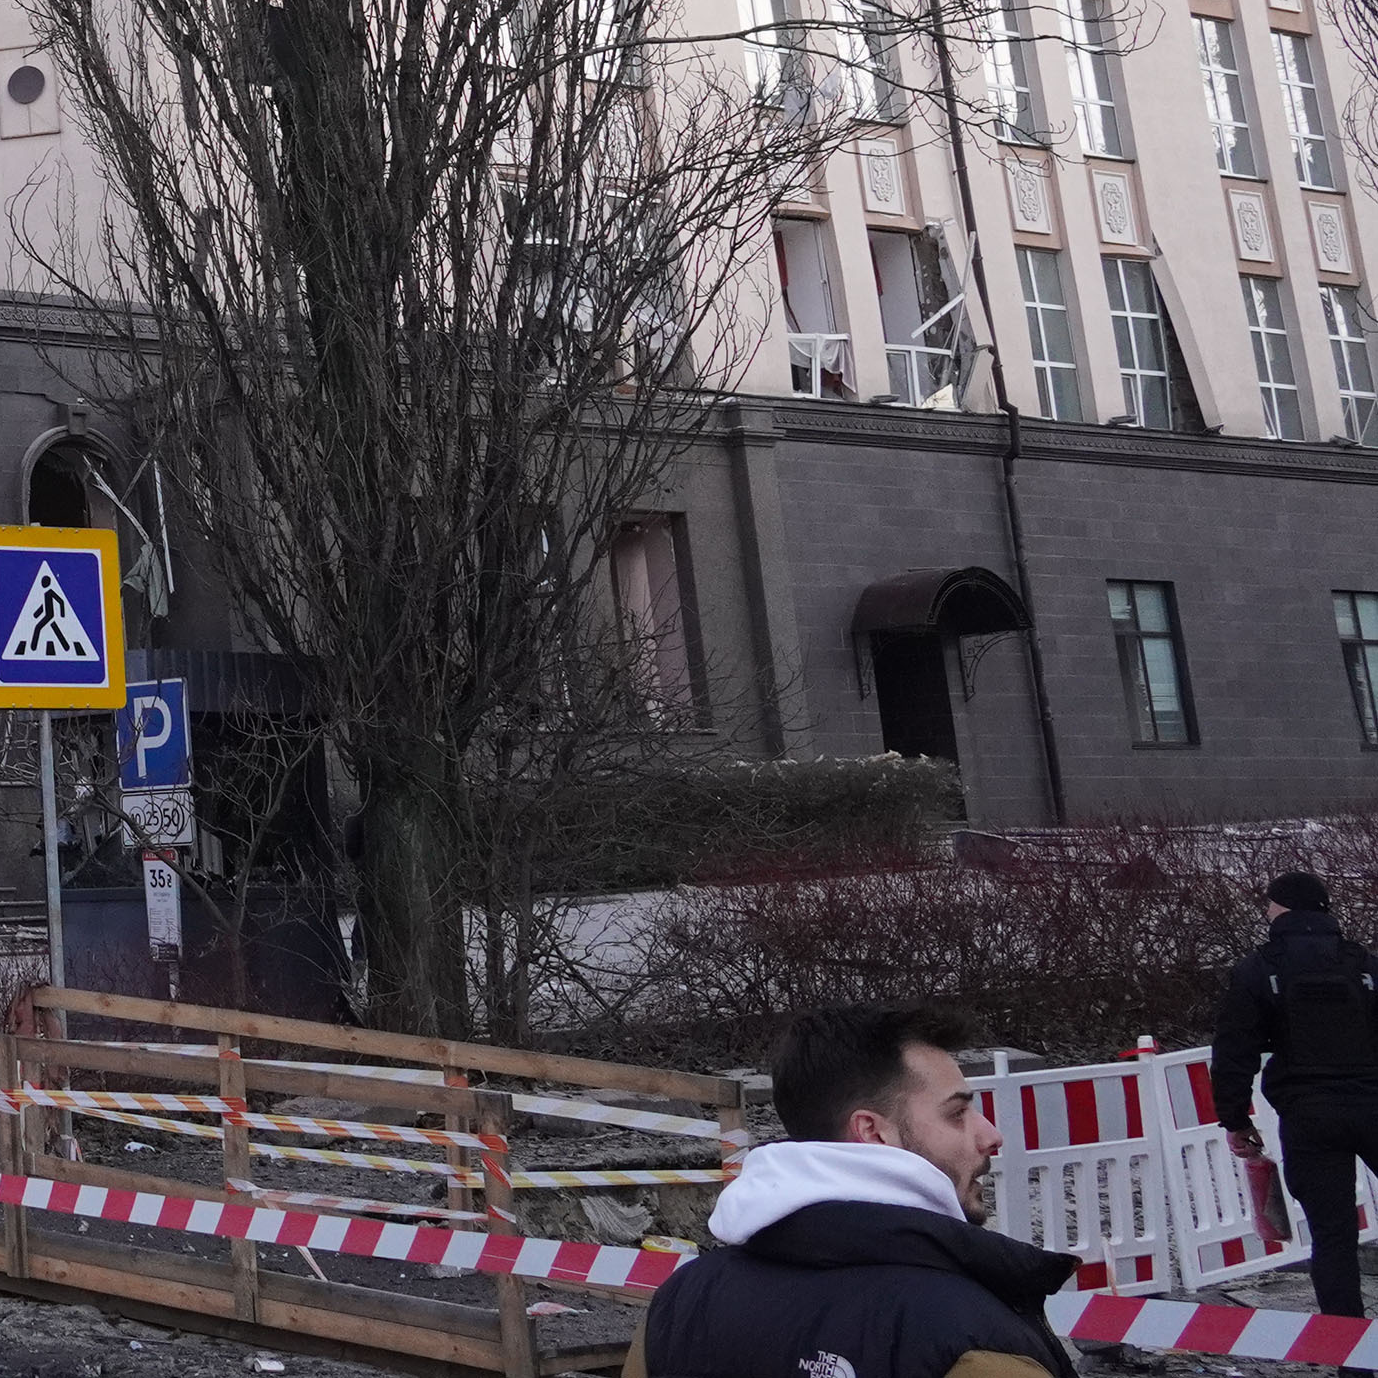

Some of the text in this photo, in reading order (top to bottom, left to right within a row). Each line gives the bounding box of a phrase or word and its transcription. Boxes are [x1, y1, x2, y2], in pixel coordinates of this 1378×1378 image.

[133, 695, 172, 778] P
[146, 811, 159, 826] 25
[163, 808, 180, 827] 50
[817, 1350, 837, 1365] THE
[798, 1358, 834, 1376] NORTH
